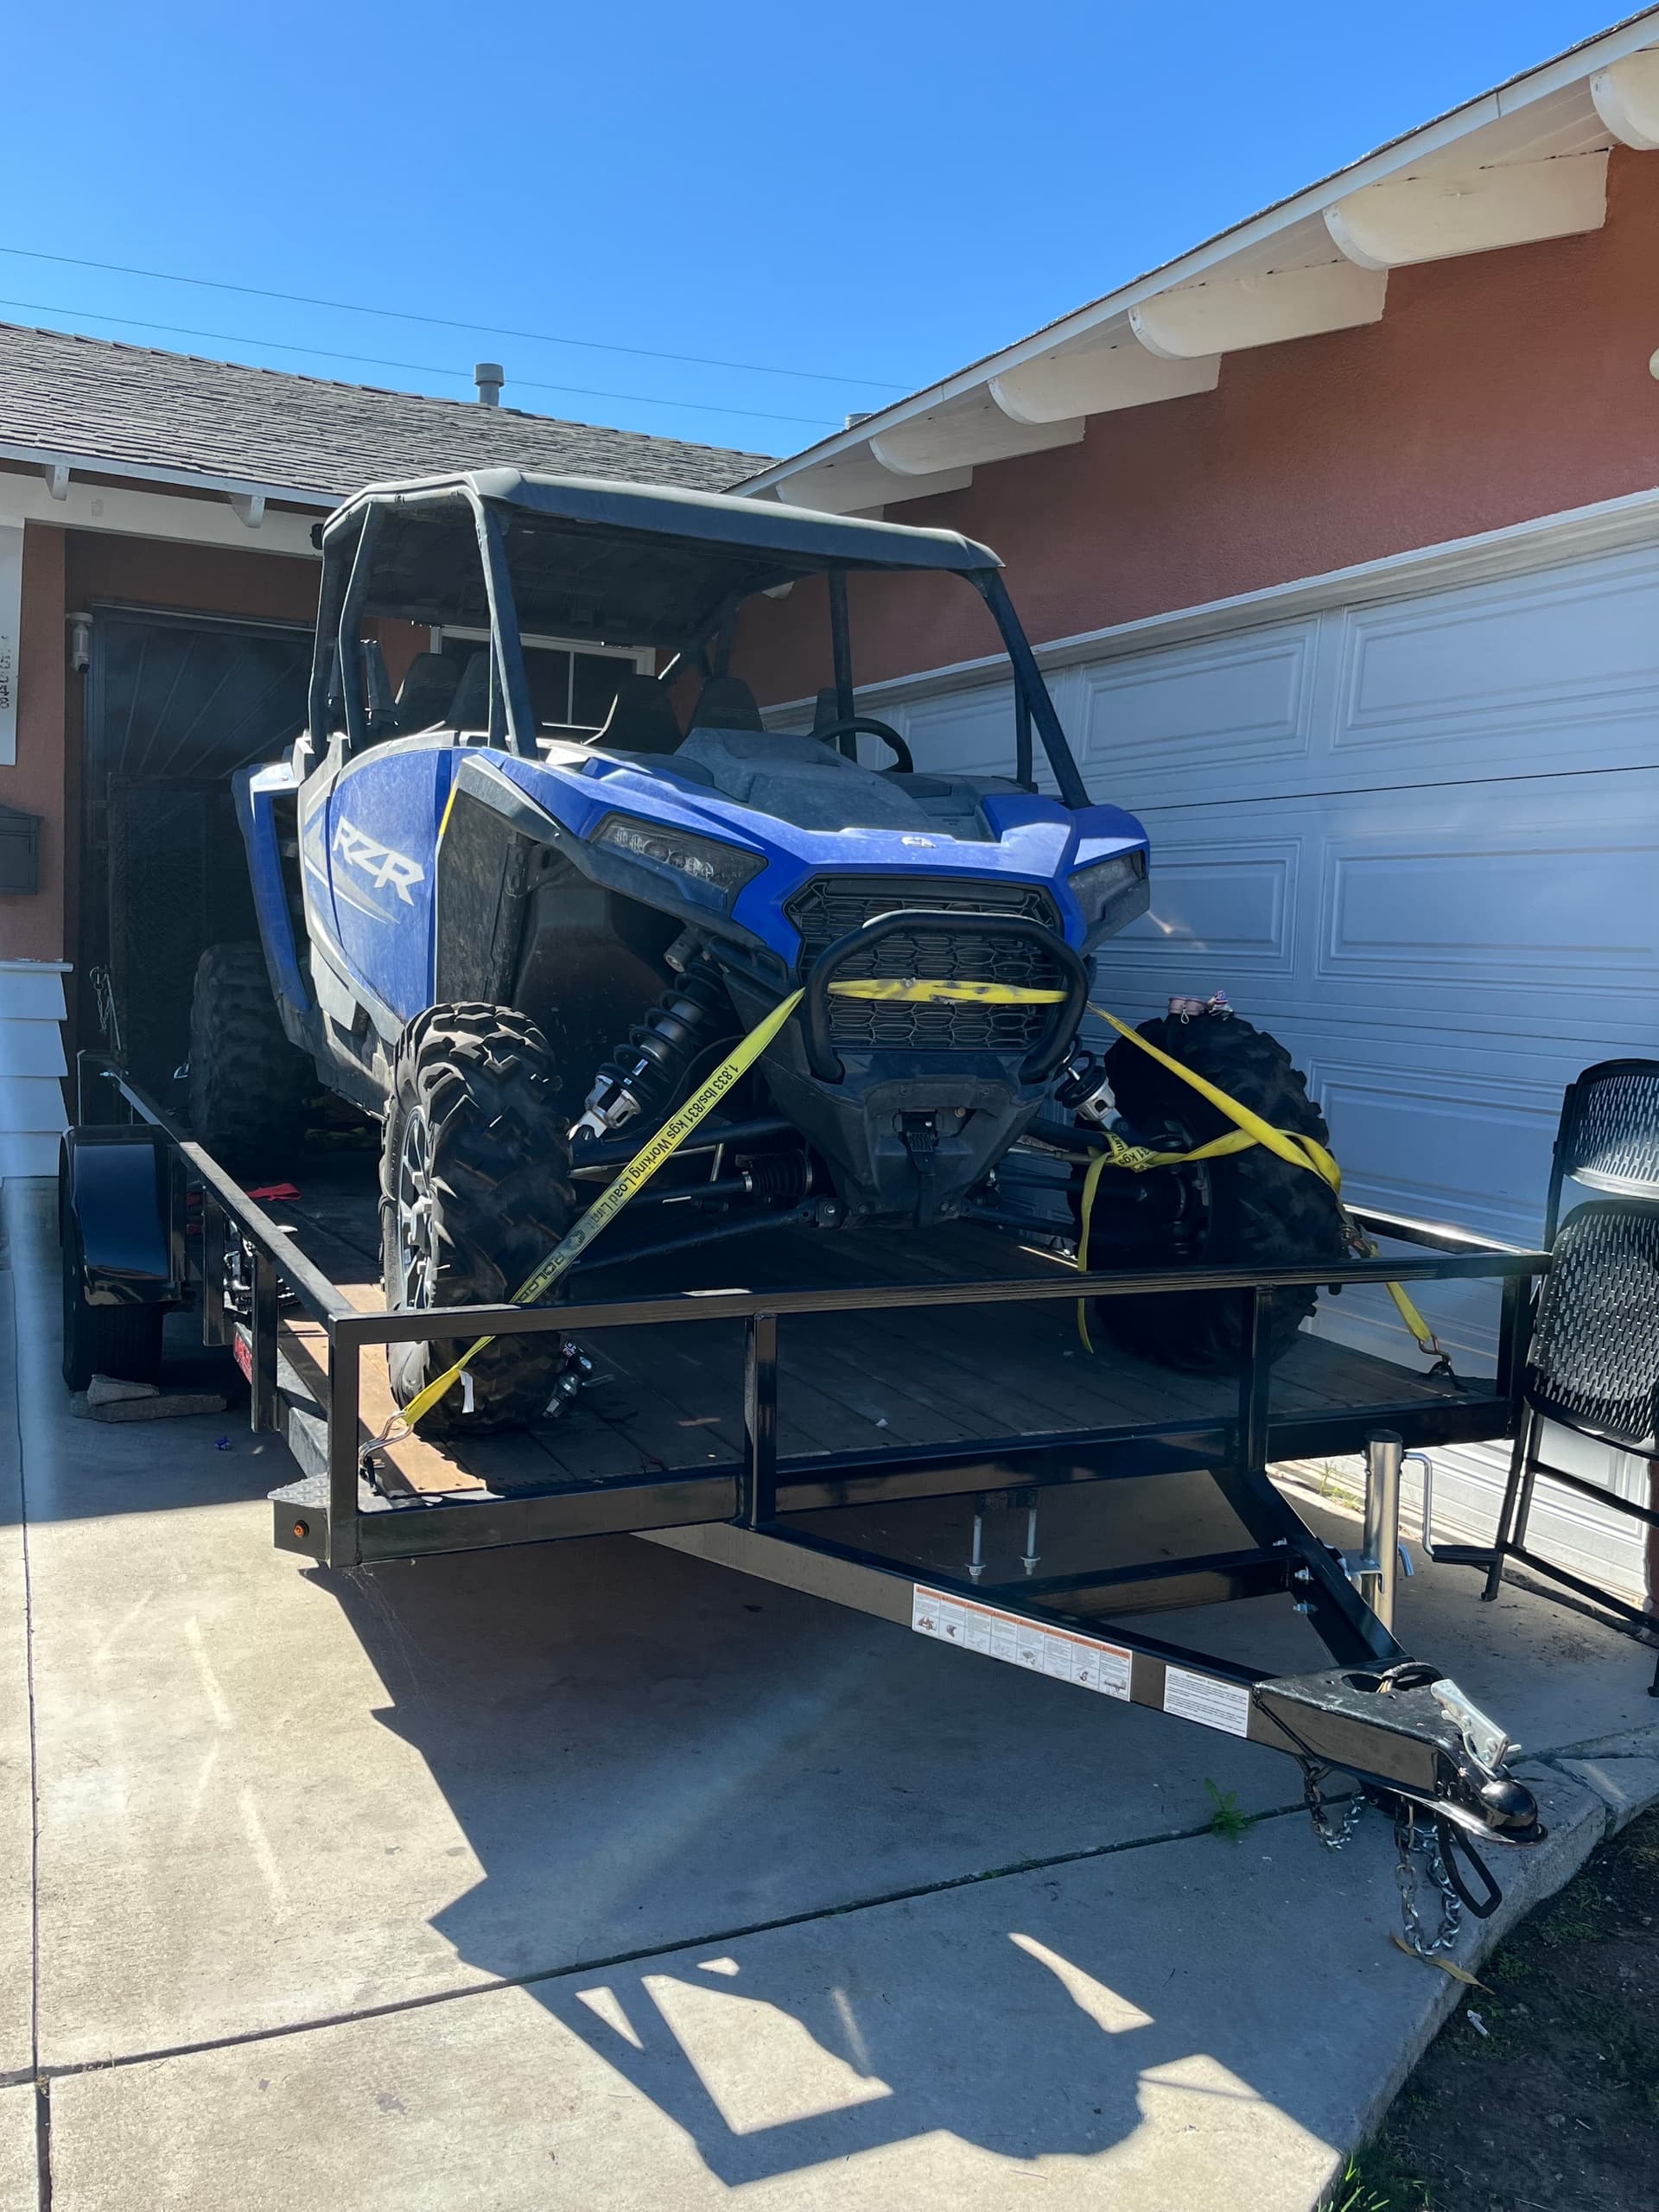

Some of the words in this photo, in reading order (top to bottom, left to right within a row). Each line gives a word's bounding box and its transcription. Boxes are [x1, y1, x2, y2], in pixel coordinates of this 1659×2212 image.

[333, 816, 425, 906] RZR
[713, 1065, 739, 1090] 1,833
[683, 1087, 718, 1123] lbs/831
[666, 1119, 689, 1140] kgs
[628, 1139, 672, 1179] Working
[607, 1176, 637, 1206] Load
